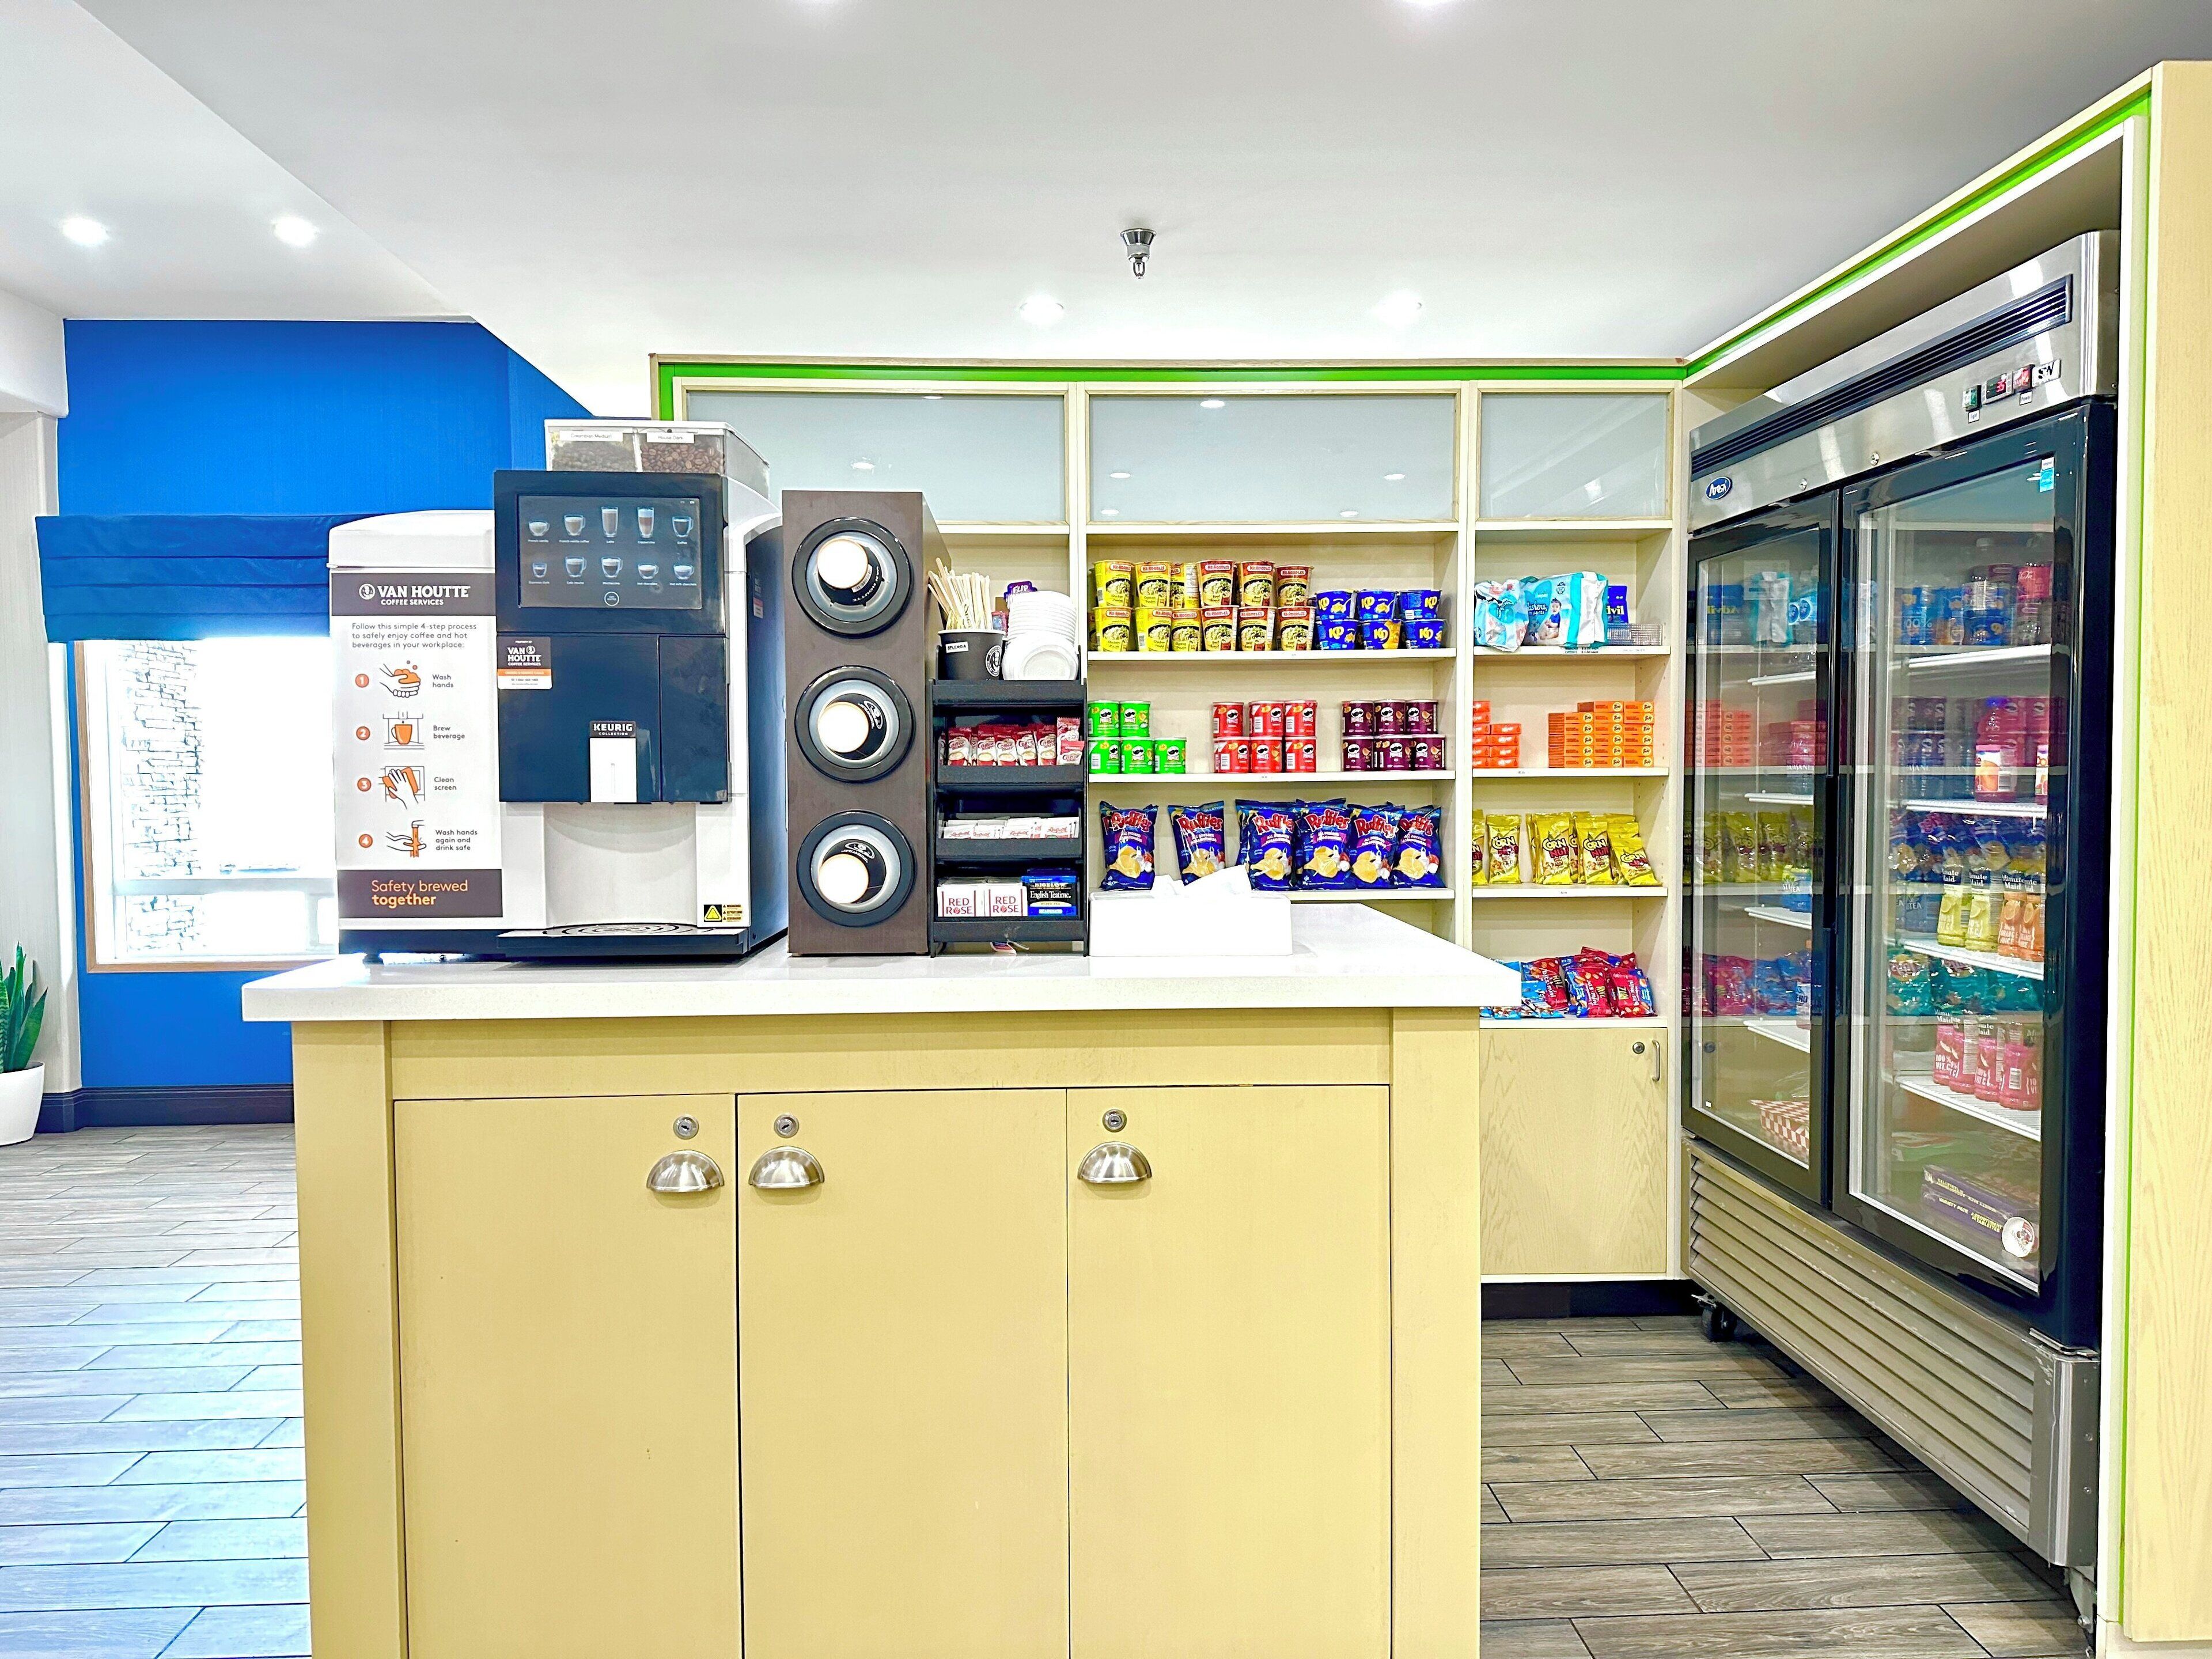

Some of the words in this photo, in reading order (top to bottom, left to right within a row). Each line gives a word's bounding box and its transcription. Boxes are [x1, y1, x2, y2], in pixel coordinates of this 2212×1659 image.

[377, 586, 407, 597] VAN
[411, 586, 471, 597] HOUTTE
[1607, 605, 1624, 615] dvil
[594, 723, 632, 732] KEURIG
[1177, 813, 1223, 831] Ruffles
[1305, 808, 1350, 831] Ruffles
[1491, 836, 1516, 850] CORN
[1542, 838, 1566, 851] CORN
[1569, 834, 1578, 848] CO
[1583, 839, 1607, 851] CORN
[1550, 847, 1569, 858] NUT
[1590, 847, 1609, 857] NUT
[1620, 853, 1646, 863] CORN
[372, 880, 415, 895] Safety
[419, 880, 468, 892] brewed
[2005, 881, 2021, 890] Maid
[372, 894, 436, 908] together
[995, 896, 1016, 904] RED
[1030, 891, 1048, 900] English
[1617, 986, 1629, 1000] RITZ
[1939, 1198, 1956, 1208] VARIETY
[1957, 1205, 1968, 1214] PACK
